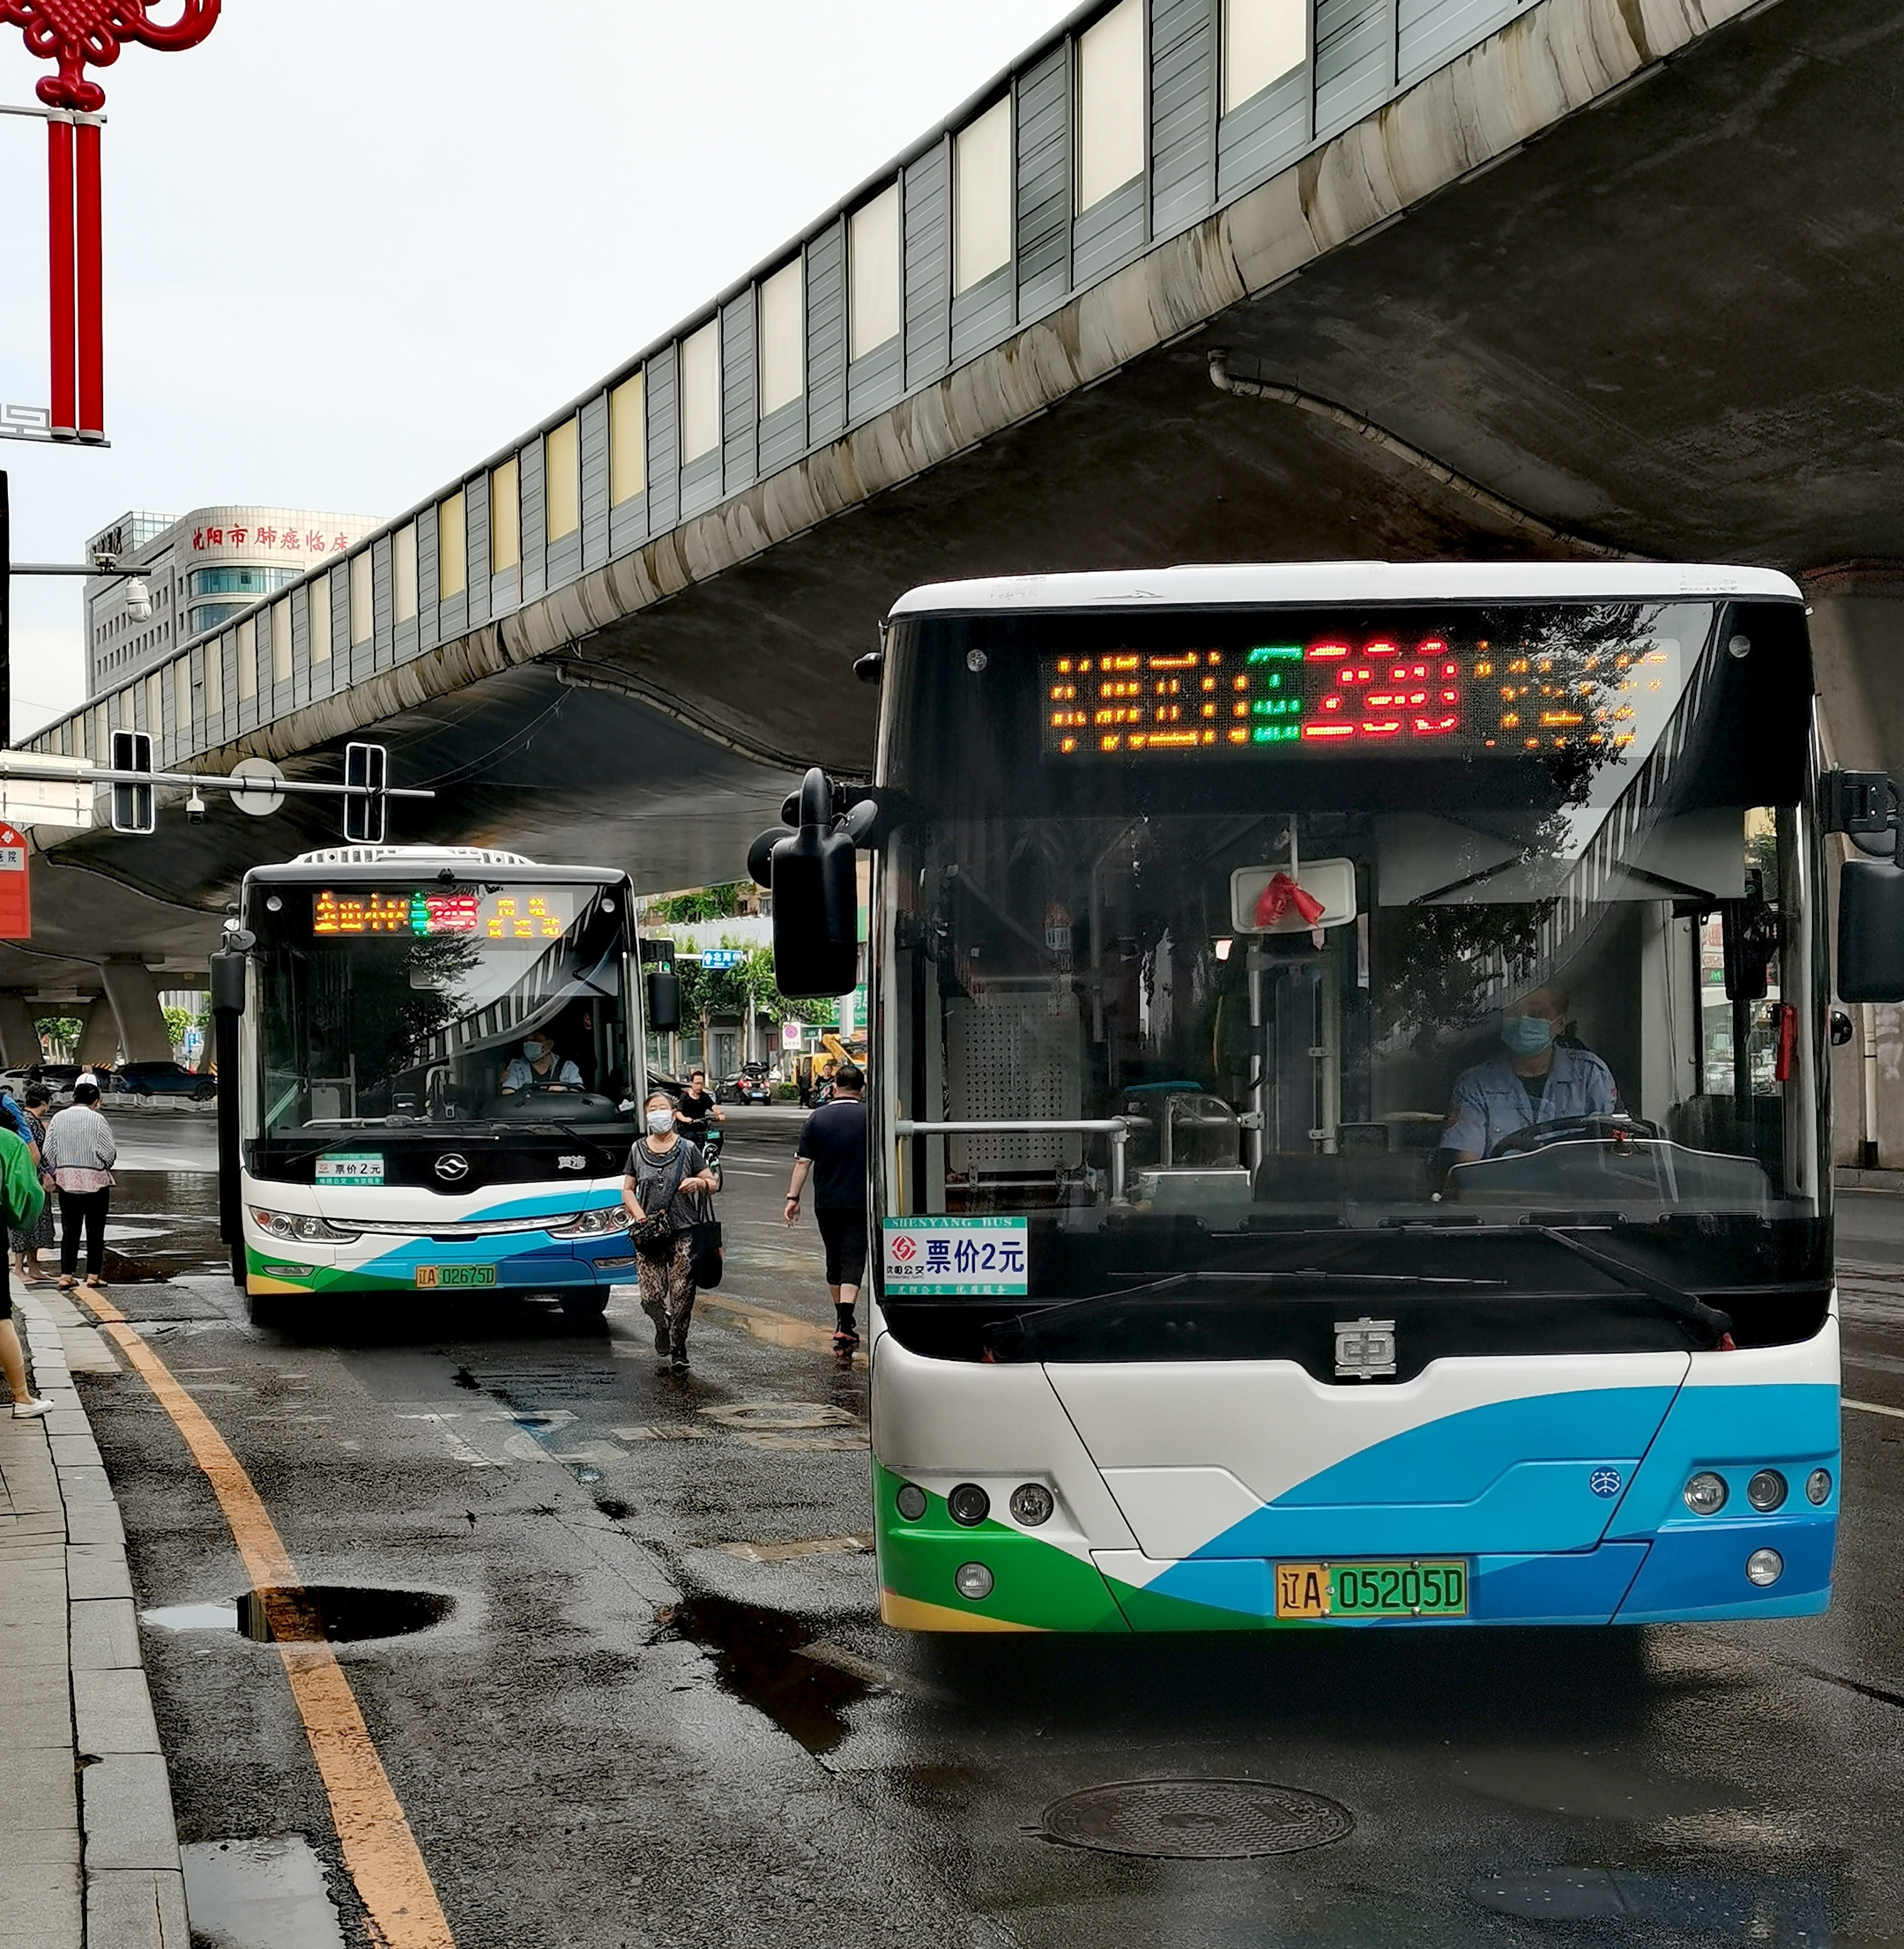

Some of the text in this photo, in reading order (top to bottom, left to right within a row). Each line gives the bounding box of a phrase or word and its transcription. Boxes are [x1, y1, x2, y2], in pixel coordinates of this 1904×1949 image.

[335, 1163, 381, 1175] 票价2元
[892, 1218, 1012, 1227] SHENYANG BUS
[926, 1239, 1025, 1274] 票价2元
